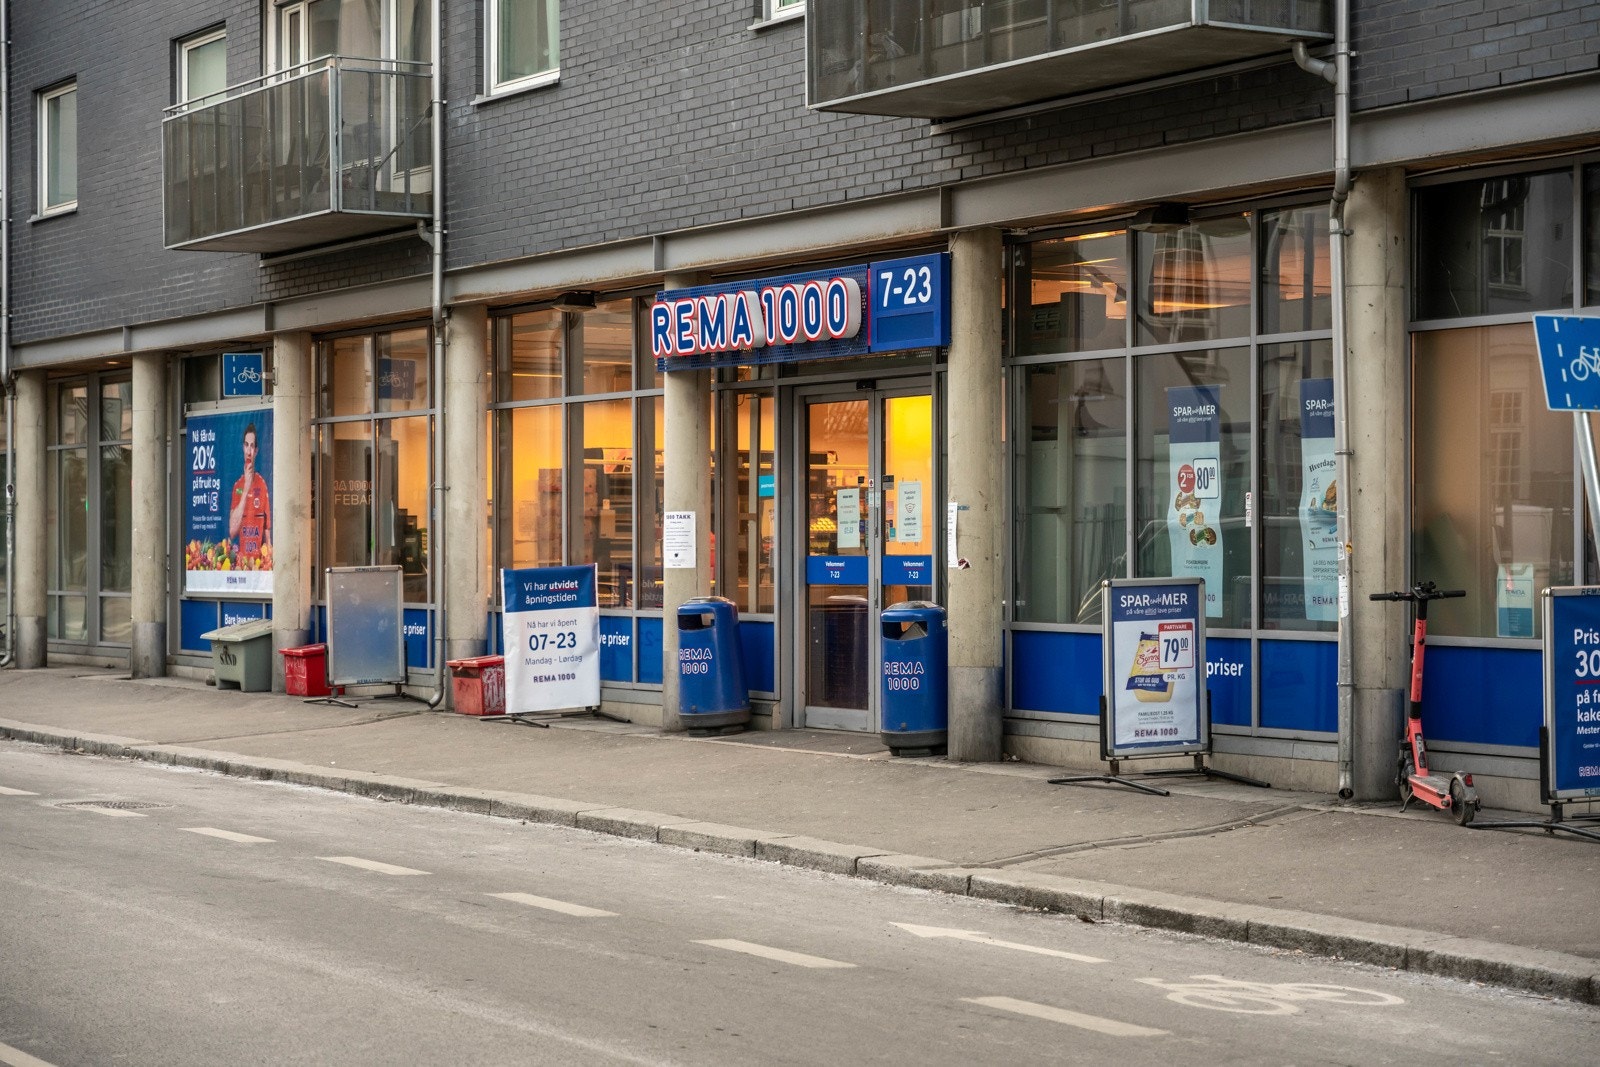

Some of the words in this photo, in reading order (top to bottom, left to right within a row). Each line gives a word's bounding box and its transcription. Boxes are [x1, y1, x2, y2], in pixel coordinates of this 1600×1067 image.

[881, 266, 932, 308] 7-23
[651, 290, 754, 358] REMA
[761, 277, 848, 346] 1000
[1173, 406, 1192, 417] SPAR
[1199, 405, 1216, 415] MER
[1305, 399, 1327, 410] SPAR
[208, 430, 215, 442] du
[192, 445, 216, 470] 20%
[212, 478, 220, 491] og
[1180, 472, 1187, 488] 2
[1197, 467, 1209, 490] 80
[830, 570, 840, 579] 7-23
[908, 570, 919, 579] 7-23
[524, 582, 533, 591] Vi
[534, 582, 547, 591] har
[549, 580, 579, 591] utvidet
[525, 593, 577, 606] åpningstiden
[1120, 594, 1150, 607] SPAR
[1162, 592, 1188, 606] MER
[1313, 596, 1333, 605] REMA
[224, 613, 236, 625] Bare
[527, 621, 537, 629] Nå
[538, 620, 548, 629] har
[550, 619, 556, 628] vi
[557, 618, 577, 628] åpent
[407, 622, 426, 637] priser
[529, 632, 577, 652] 07-23
[608, 632, 630, 647] priser
[1163, 638, 1180, 663] 79
[1180, 637, 1189, 649] 00
[525, 657, 553, 666] Mandag
[558, 654, 582, 664] Lørdag
[1575, 650, 1600, 678] 30
[884, 661, 925, 676] REMA
[1206, 658, 1244, 678] priser
[533, 674, 556, 683] REMA
[558, 673, 576, 681] 1000
[888, 677, 920, 691] 1000
[1576, 689, 1590, 706] på
[1134, 729, 1158, 738] REMA
[1160, 727, 1179, 736] 1000
